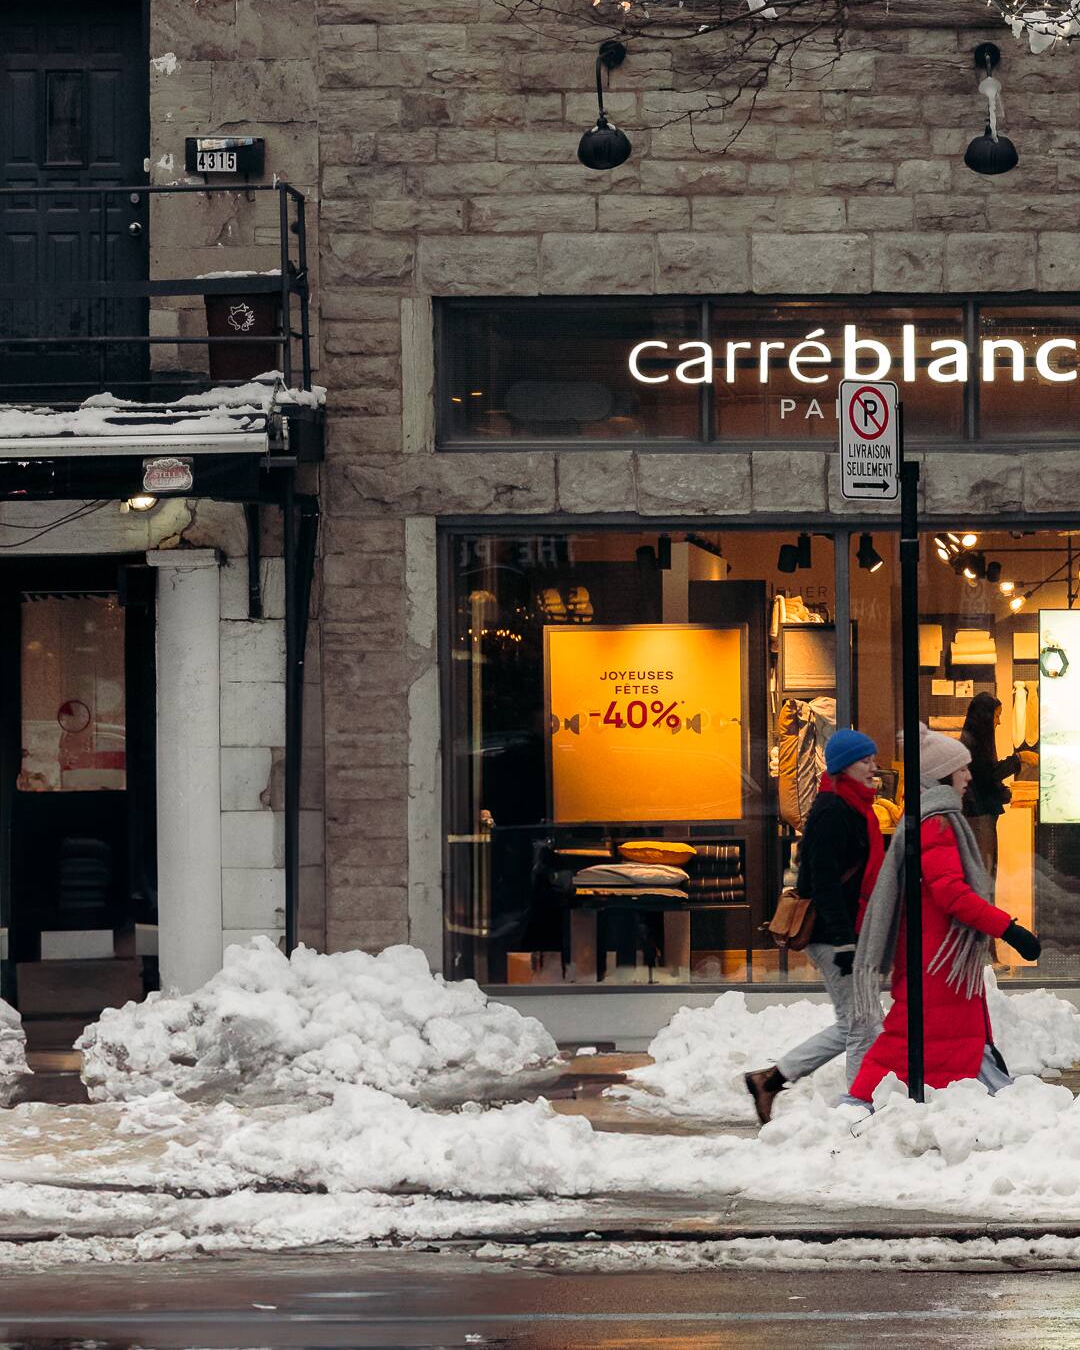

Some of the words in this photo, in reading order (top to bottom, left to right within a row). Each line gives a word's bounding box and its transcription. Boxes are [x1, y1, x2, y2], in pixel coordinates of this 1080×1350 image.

[198, 153, 235, 169] 4315
[628, 324, 1078, 384] carréblanc
[863, 399, 878, 427] P
[848, 443, 891, 459] LIVRAISON
[846, 461, 893, 477] SEULEMENT
[600, 671, 674, 681] JOYEUSES
[615, 683, 659, 695] FÊTES
[589, 700, 680, 729] -40%
